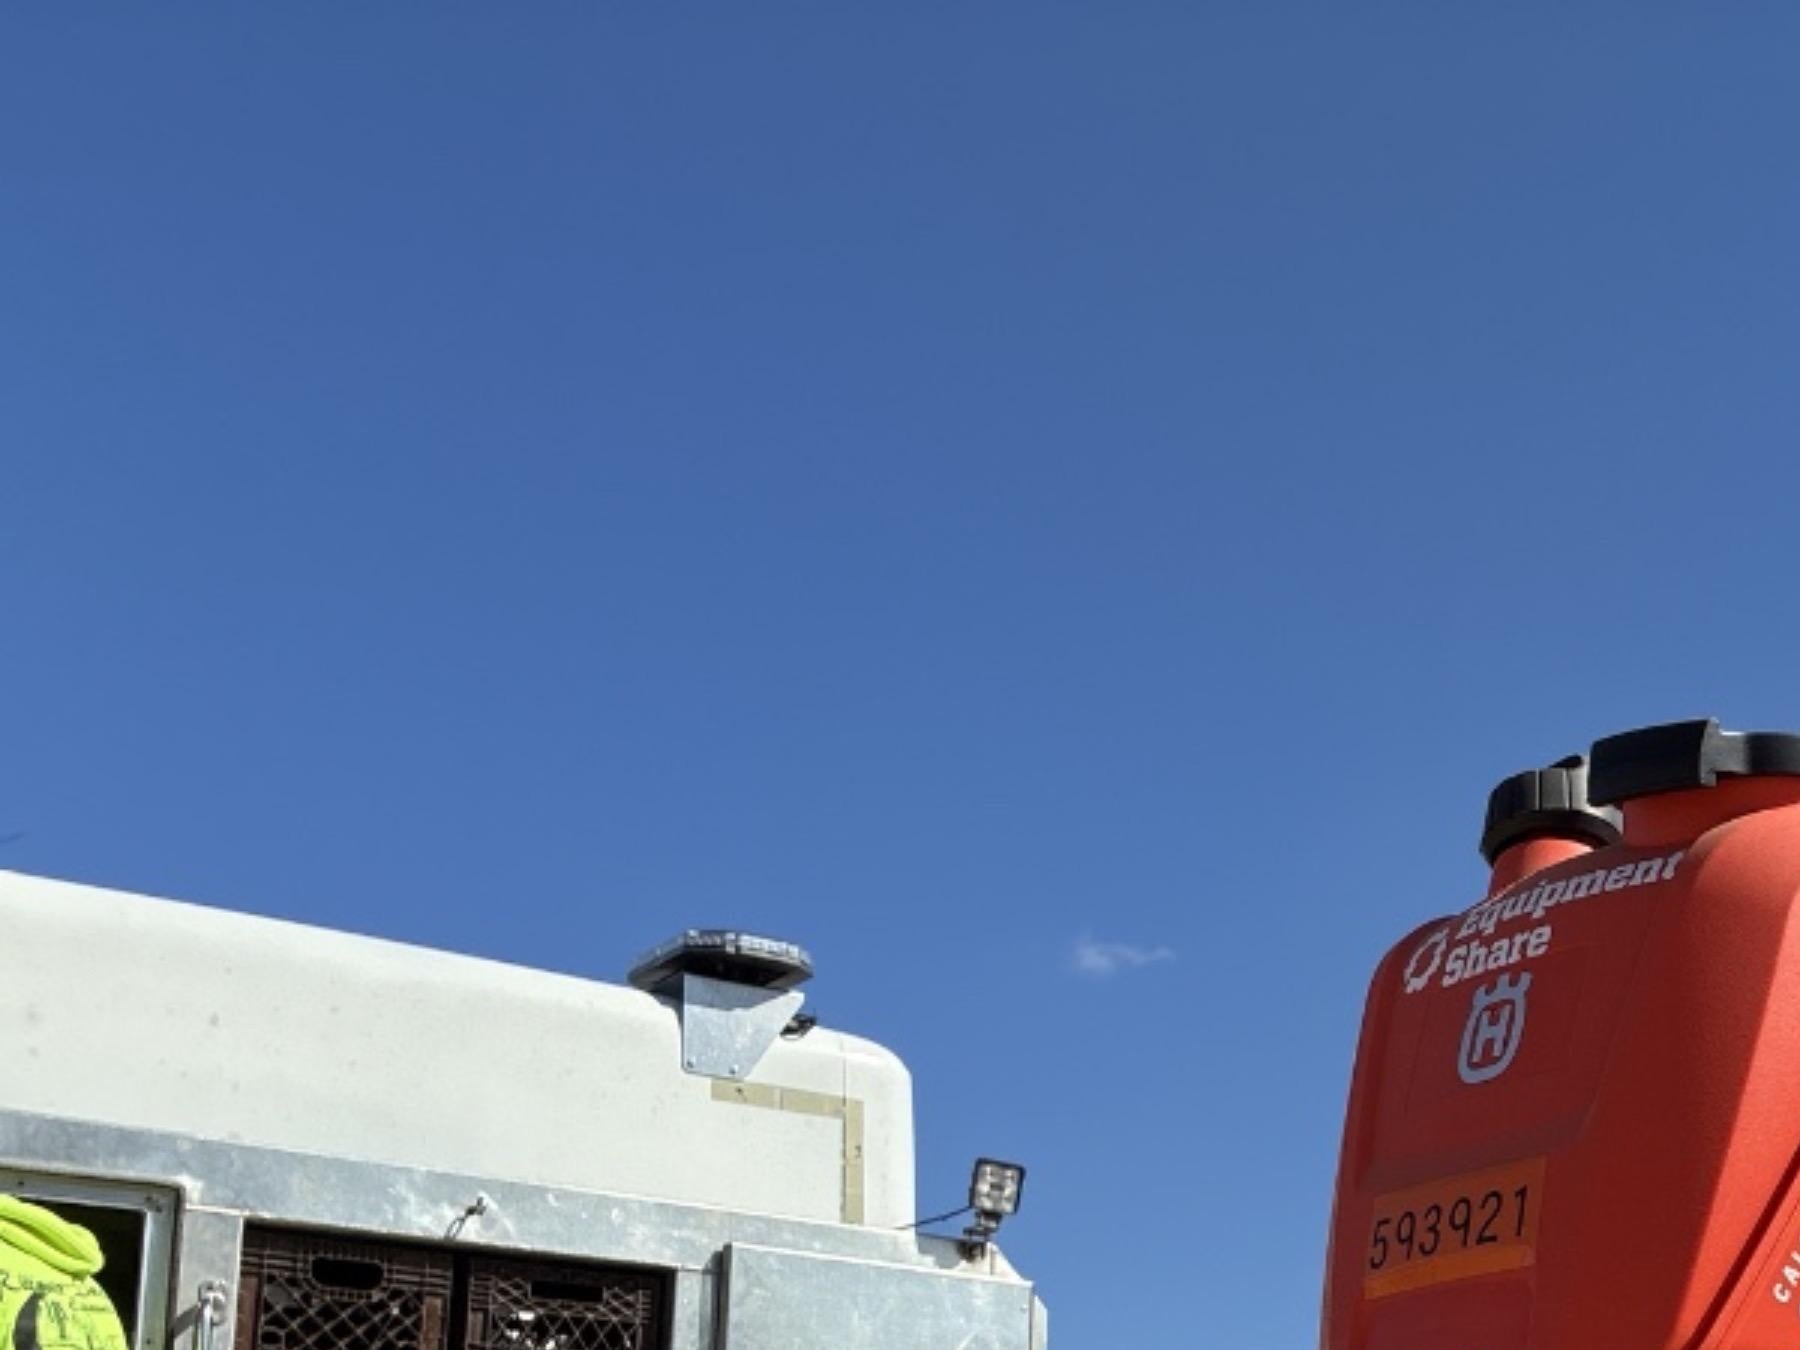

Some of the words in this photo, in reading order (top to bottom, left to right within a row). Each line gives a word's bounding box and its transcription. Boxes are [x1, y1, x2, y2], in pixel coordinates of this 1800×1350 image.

[1455, 851, 1685, 941] Equipment
[1442, 924, 1552, 989] Share
[1369, 1183, 1528, 1271] 593921
